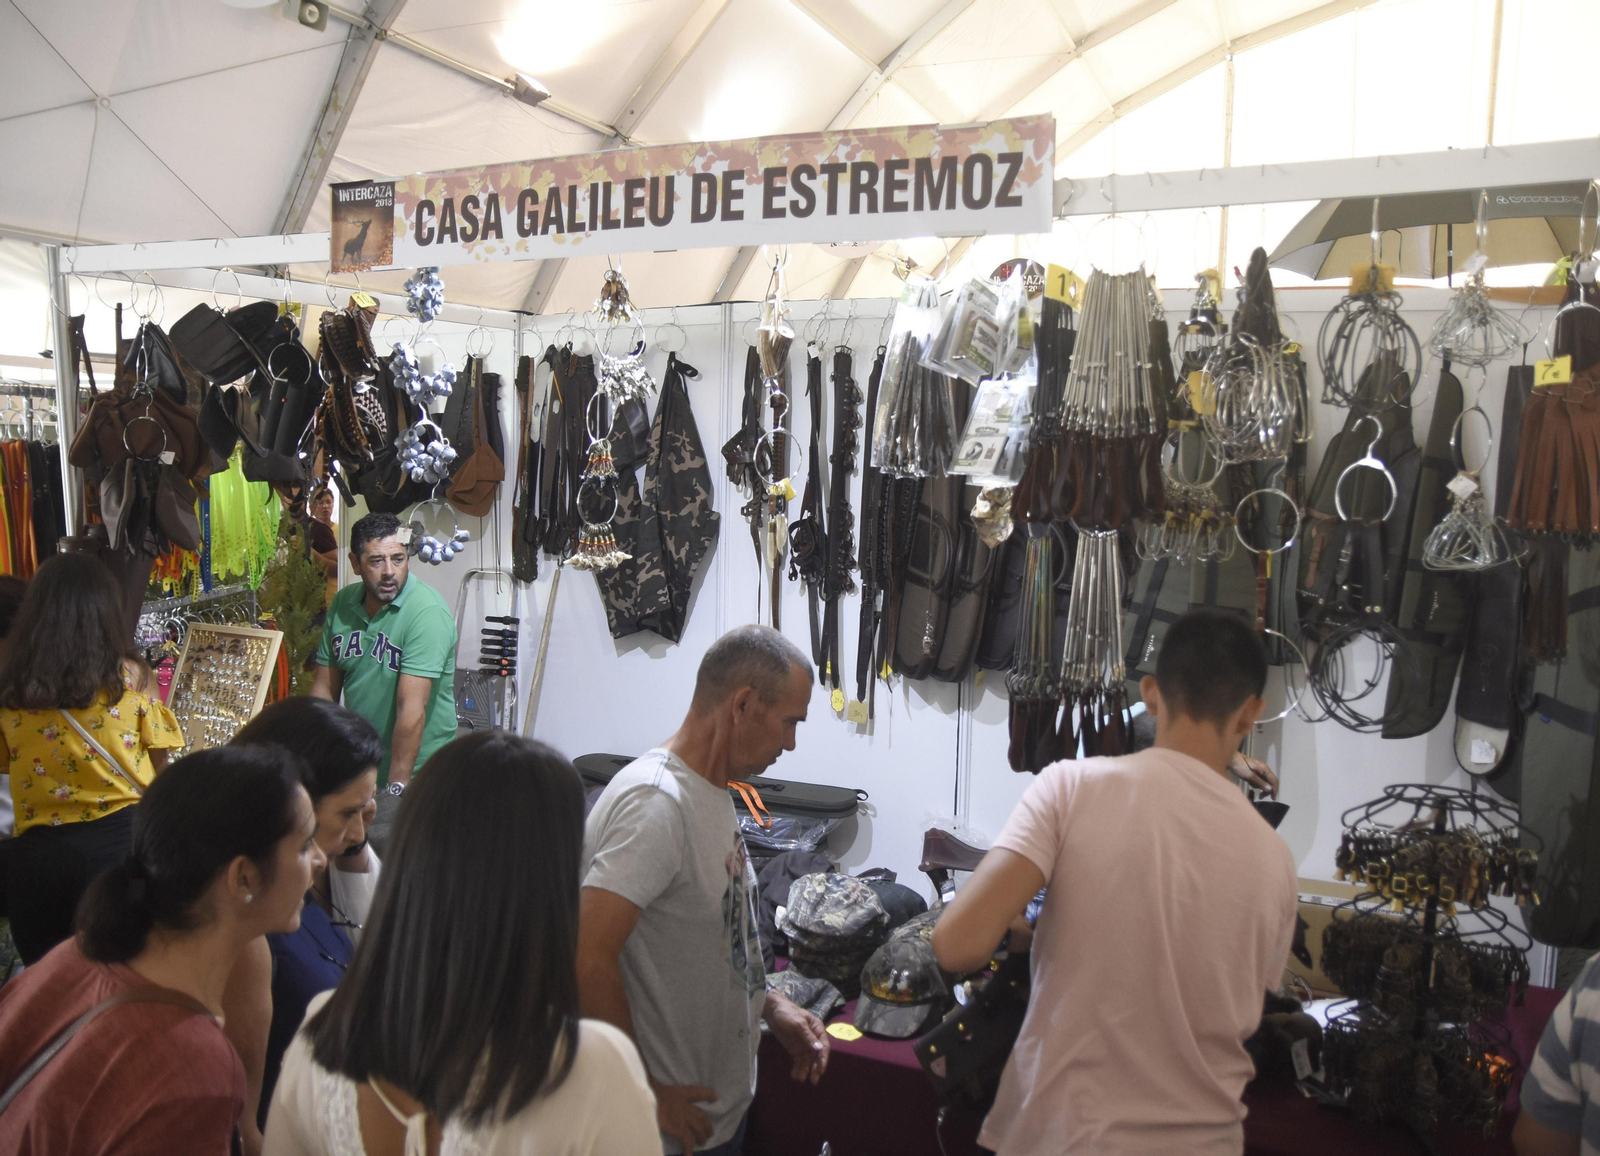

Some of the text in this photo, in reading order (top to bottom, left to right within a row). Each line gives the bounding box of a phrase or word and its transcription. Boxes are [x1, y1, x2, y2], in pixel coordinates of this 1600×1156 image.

[338, 185, 393, 202] INTERCAZA
[415, 152, 1024, 246] CASA GALILEU DE ESTREMOZ
[331, 630, 402, 672] GANT
